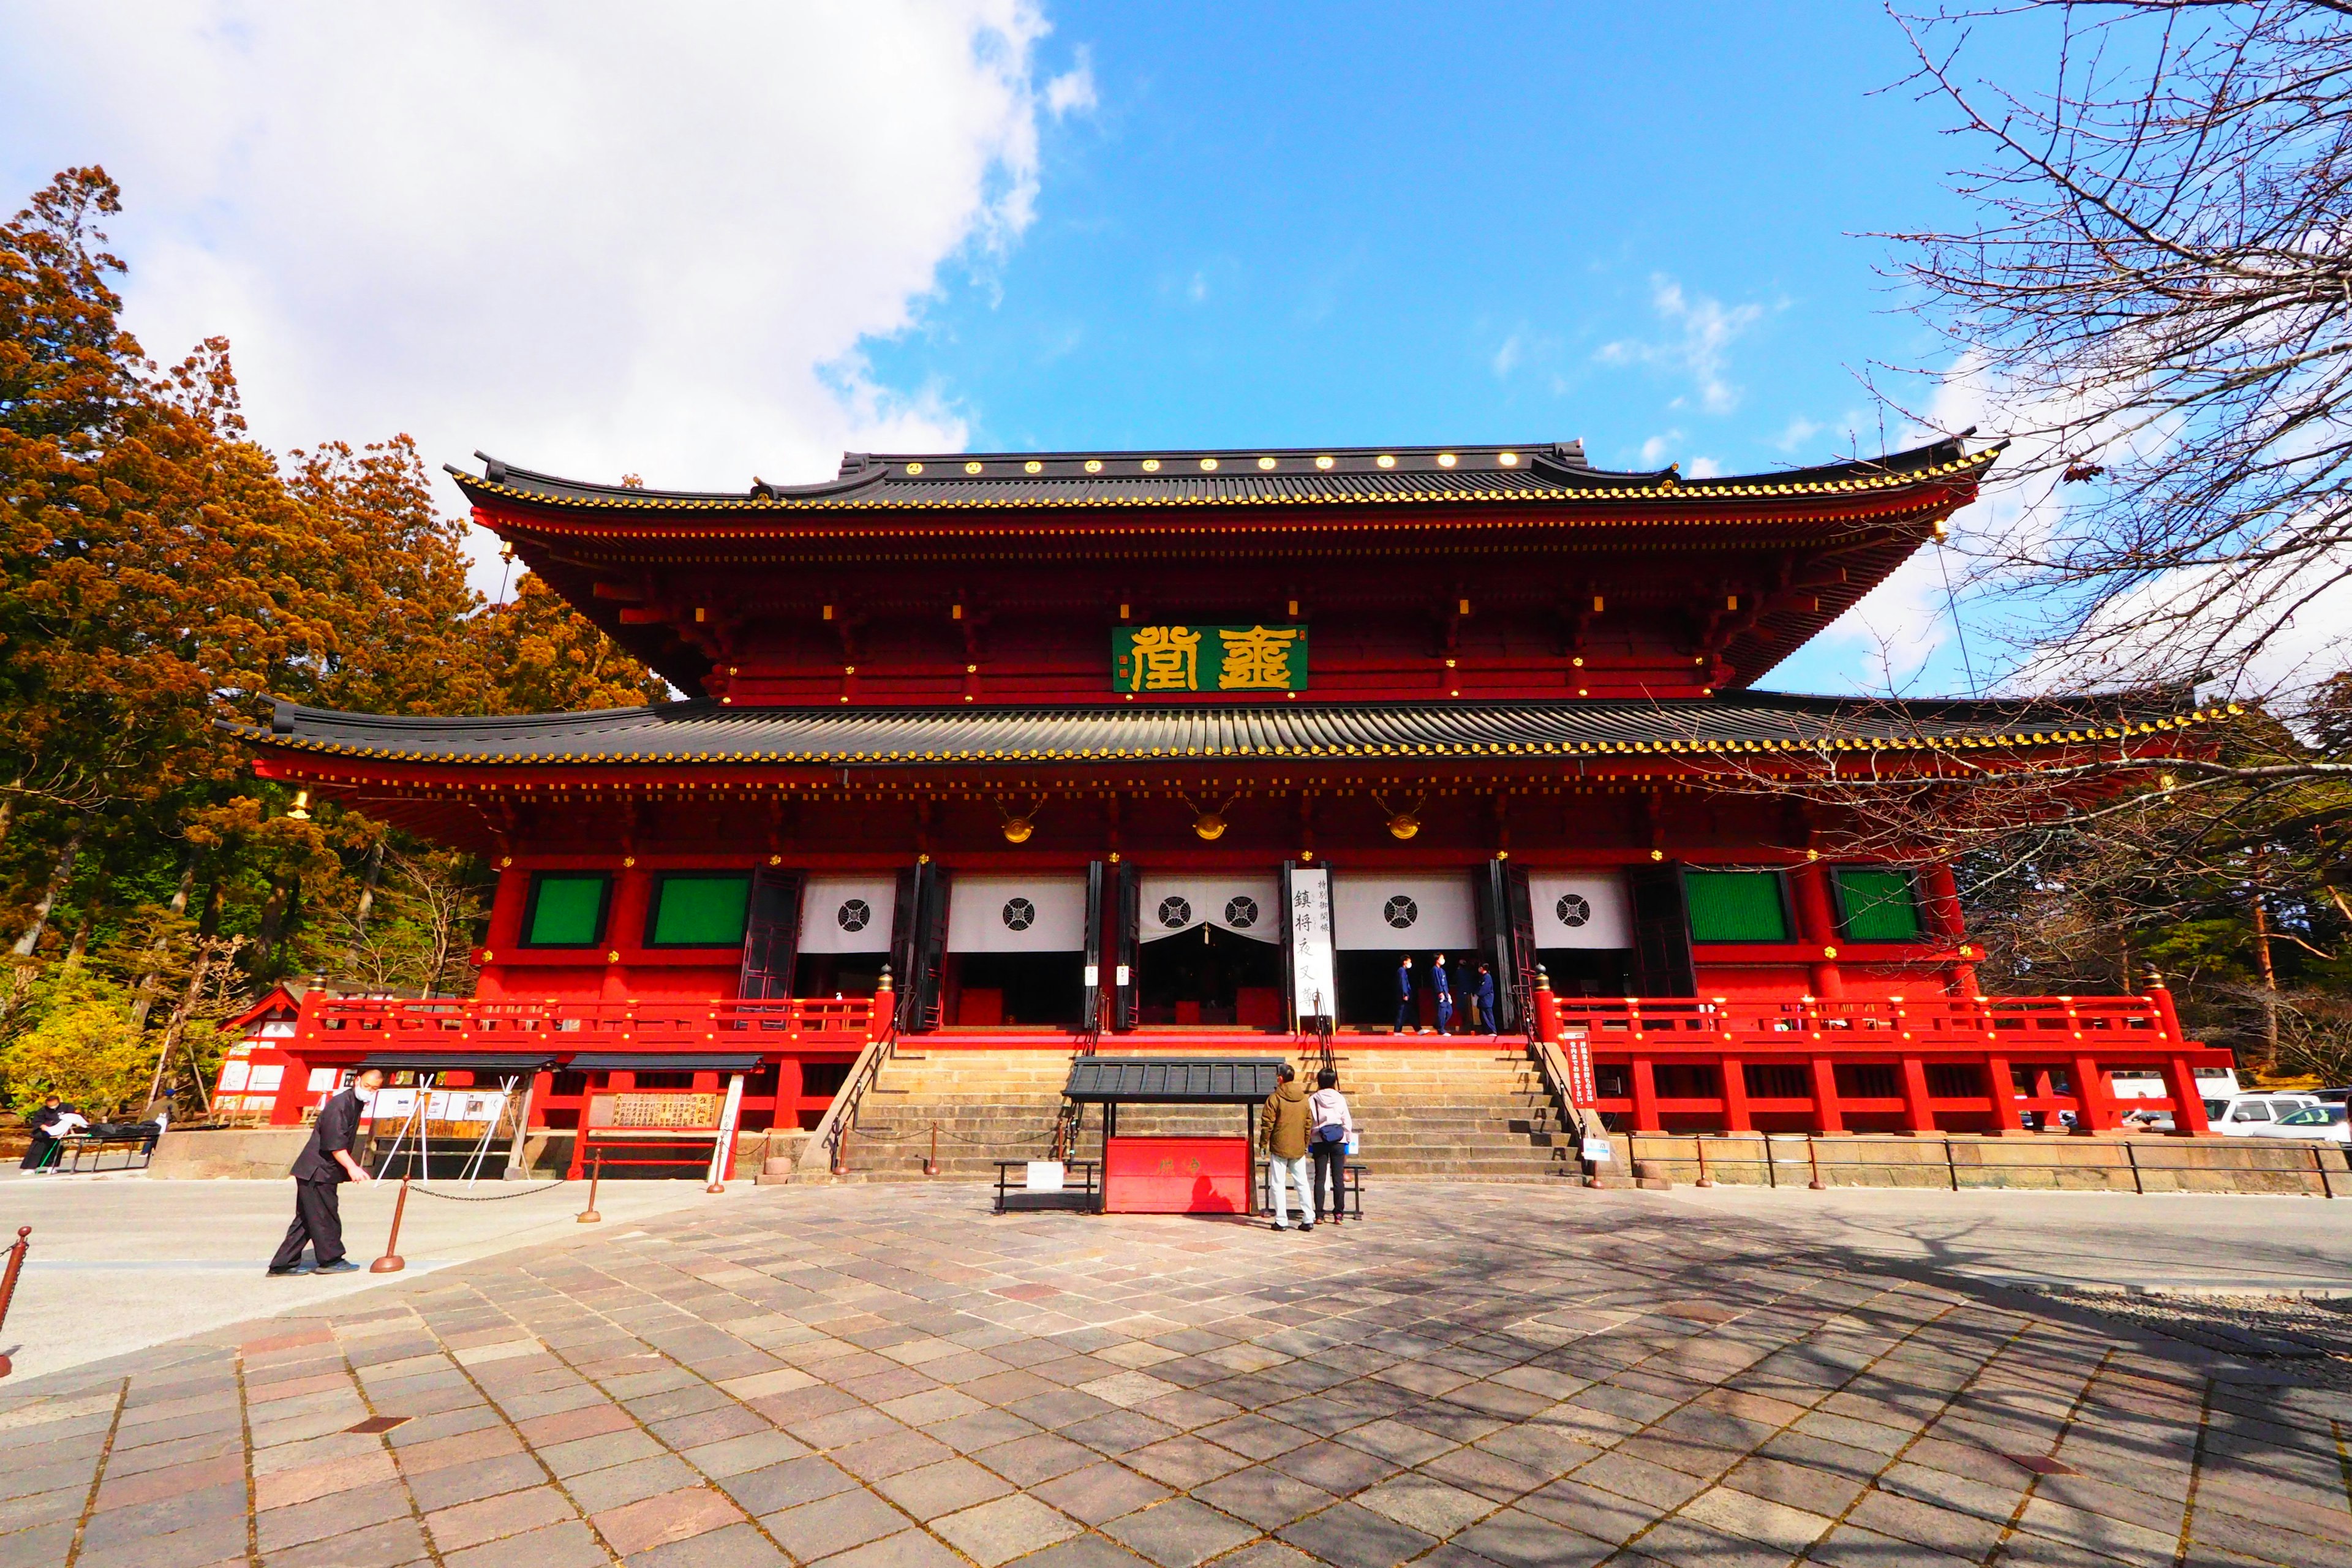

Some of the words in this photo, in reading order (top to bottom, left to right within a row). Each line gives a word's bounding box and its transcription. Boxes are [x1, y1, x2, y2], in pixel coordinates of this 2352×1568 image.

[1293, 889, 1315, 1007] 鎮将夜叉尊
[1317, 879, 1330, 932] 特別御開帳
